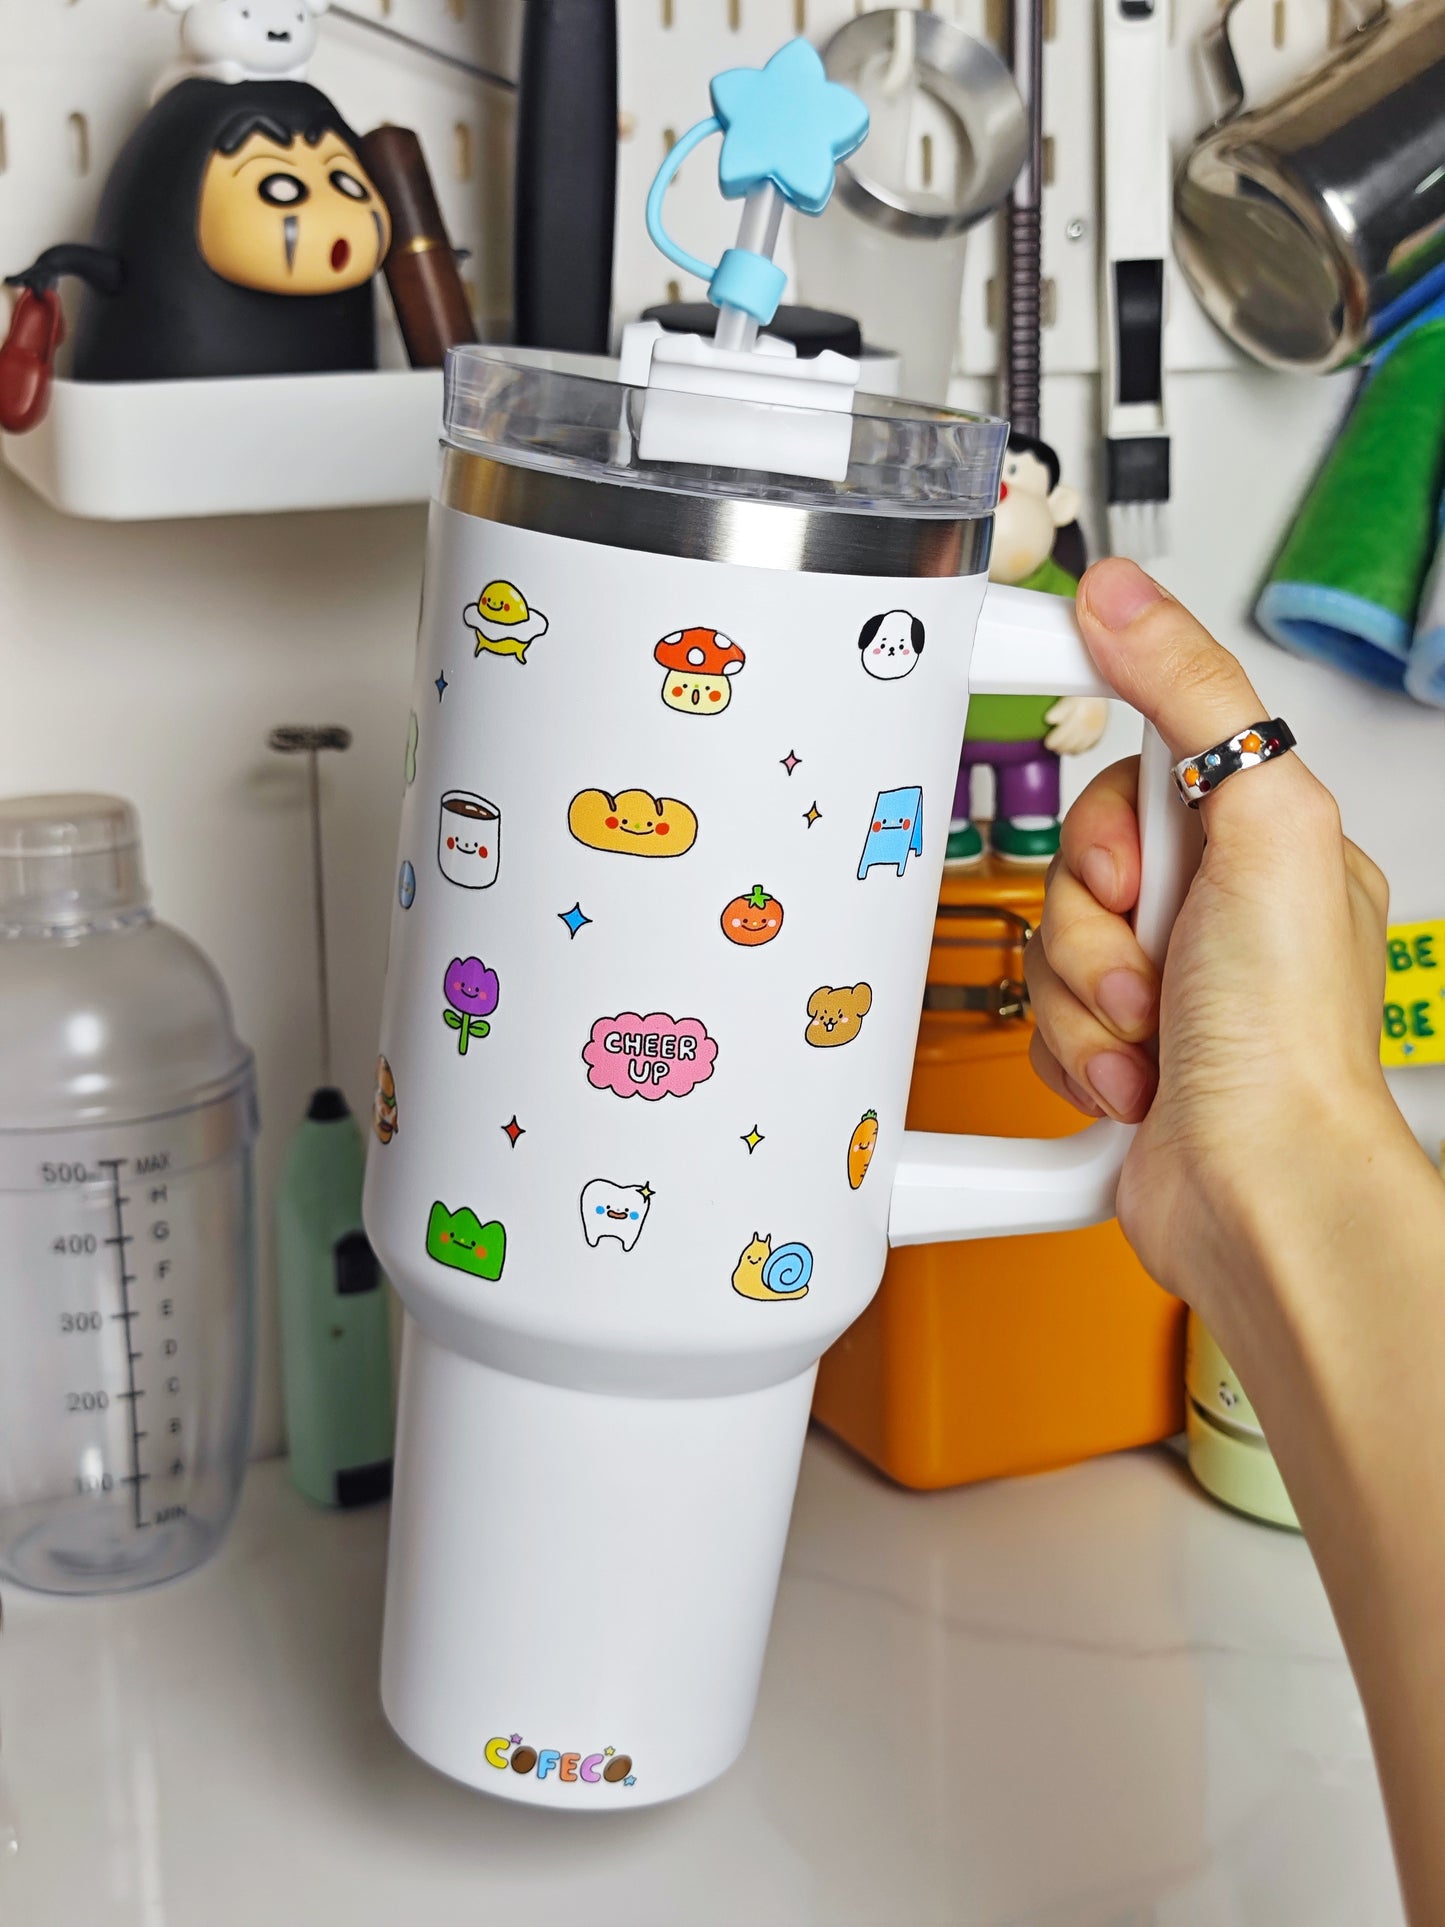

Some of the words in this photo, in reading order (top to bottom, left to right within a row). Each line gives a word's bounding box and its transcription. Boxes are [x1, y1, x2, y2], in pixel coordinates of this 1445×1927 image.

[1388, 936, 1437, 971] BE
[1384, 1001, 1435, 1038] BE
[604, 1031, 697, 1060] CHEER
[628, 1058, 670, 1085] UP
[41, 1162, 87, 1183] 500
[136, 1153, 170, 1175] MAX
[152, 1221, 170, 1241] G
[53, 1233, 97, 1255] 400
[61, 1311, 103, 1332] 300
[67, 1391, 109, 1411] 200
[156, 1505, 187, 1524] MIN
[485, 1737, 633, 1783] COFECO
